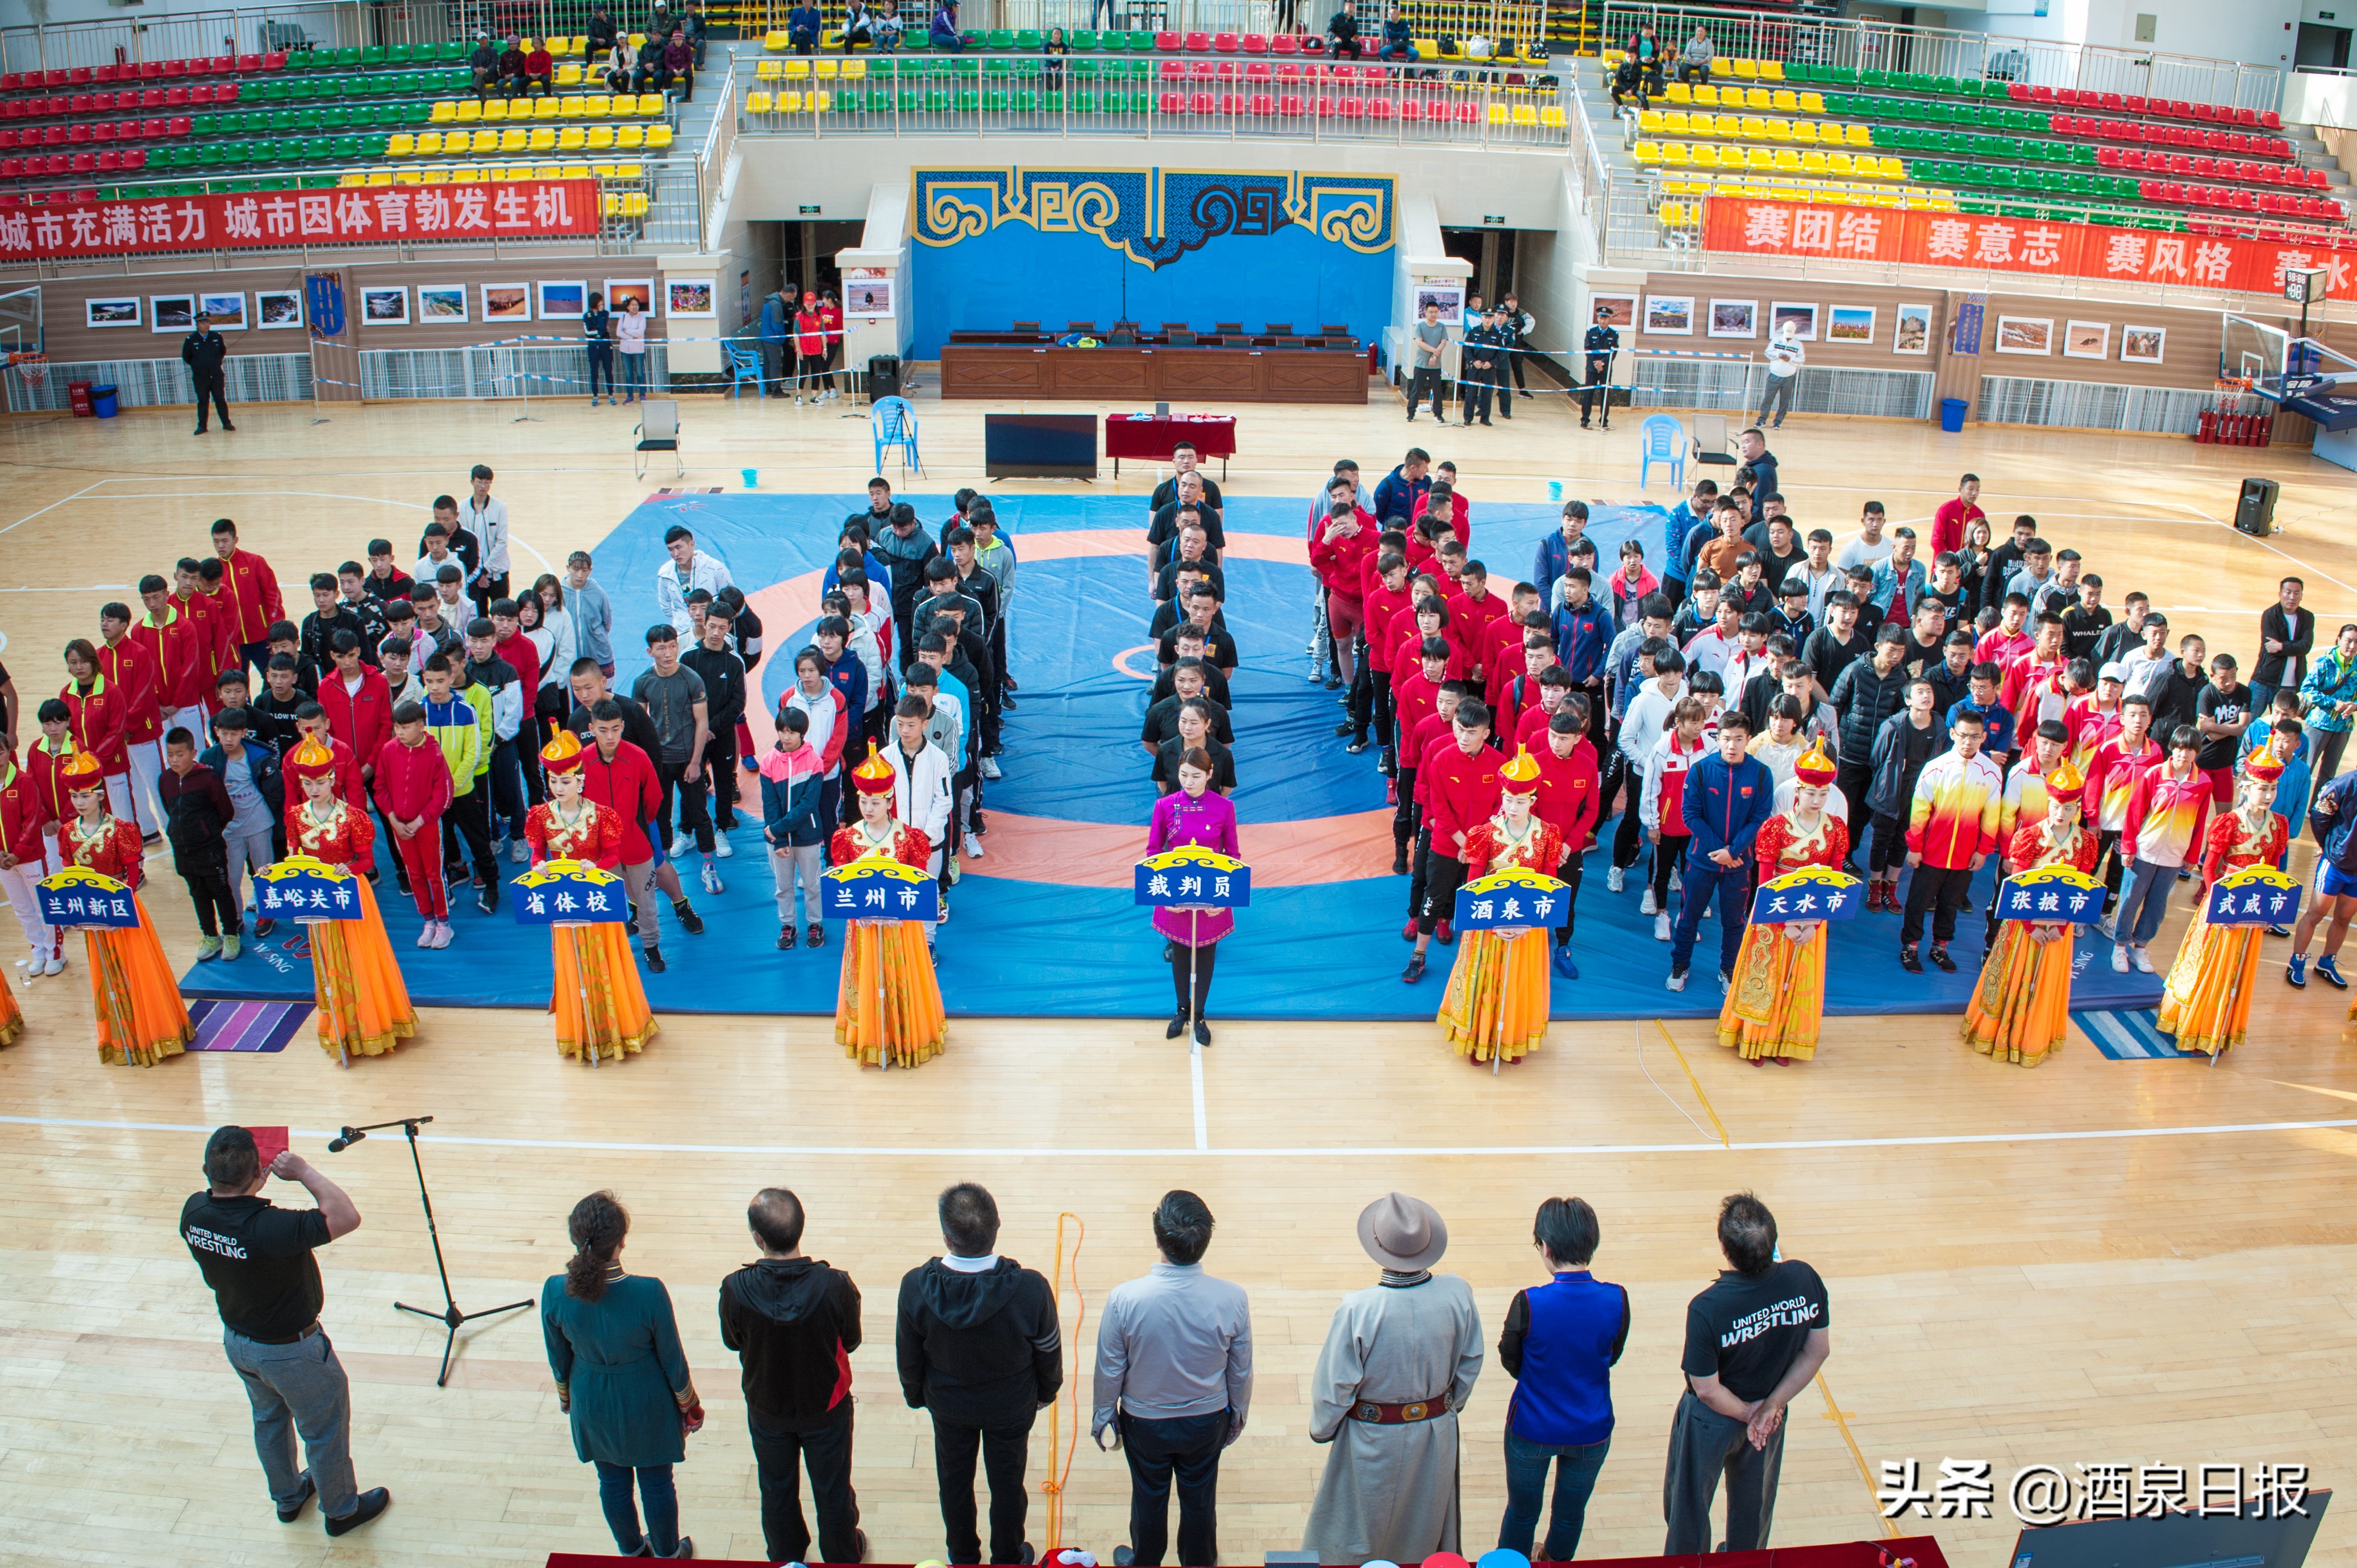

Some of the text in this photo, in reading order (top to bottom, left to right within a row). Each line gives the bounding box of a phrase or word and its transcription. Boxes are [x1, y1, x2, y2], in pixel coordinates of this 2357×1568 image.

[0, 186, 572, 251] 城市充满活力 城市因体育勃发生机
[1744, 206, 2357, 292] 赛团结 赛意志 赛风格 赛水
[263, 886, 351, 910] 嘉峪关市
[1147, 874, 1231, 898] 裁判员
[49, 896, 130, 918] 兰州新区
[525, 890, 611, 915] 省体校
[834, 887, 920, 911] 兰州市
[1471, 895, 1556, 920] 酒泉市
[1766, 891, 1847, 914] 天水市
[2012, 891, 2090, 914] 张掖市
[2218, 893, 2288, 915] 武威市
[186, 1231, 247, 1259] WRESTLING
[190, 1224, 237, 1246] UNITED WORLD
[1733, 1295, 1806, 1330] UNITED WORLD
[1721, 1303, 1819, 1348] WRESTLING
